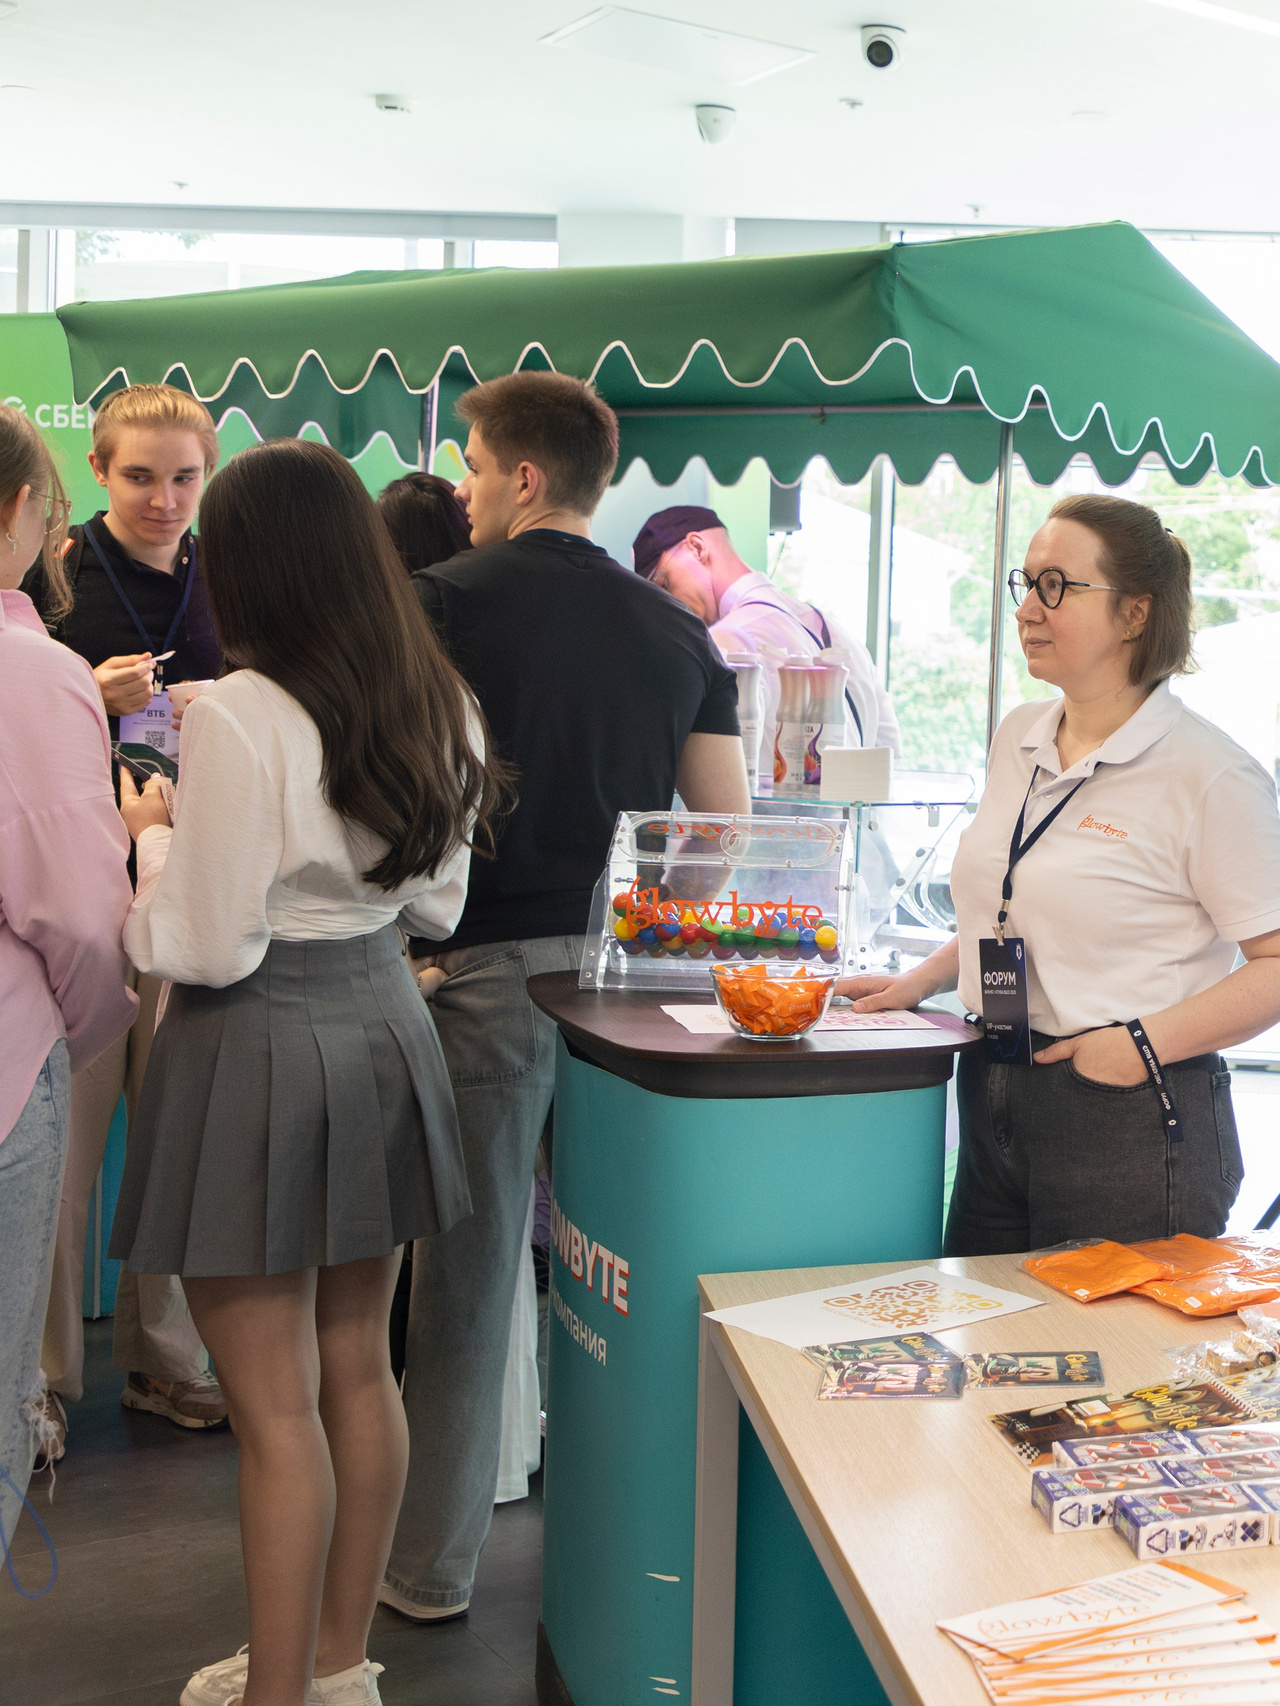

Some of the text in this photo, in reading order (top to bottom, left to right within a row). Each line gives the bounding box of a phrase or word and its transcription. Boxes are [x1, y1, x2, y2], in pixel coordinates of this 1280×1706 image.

[147, 709, 165, 718] ВТБ
[1077, 814, 1128, 839] glowbyte
[625, 876, 823, 942] glowbyte
[984, 971, 1016, 986] ФОРУМ
[551, 1197, 630, 1318] OWBYTE
